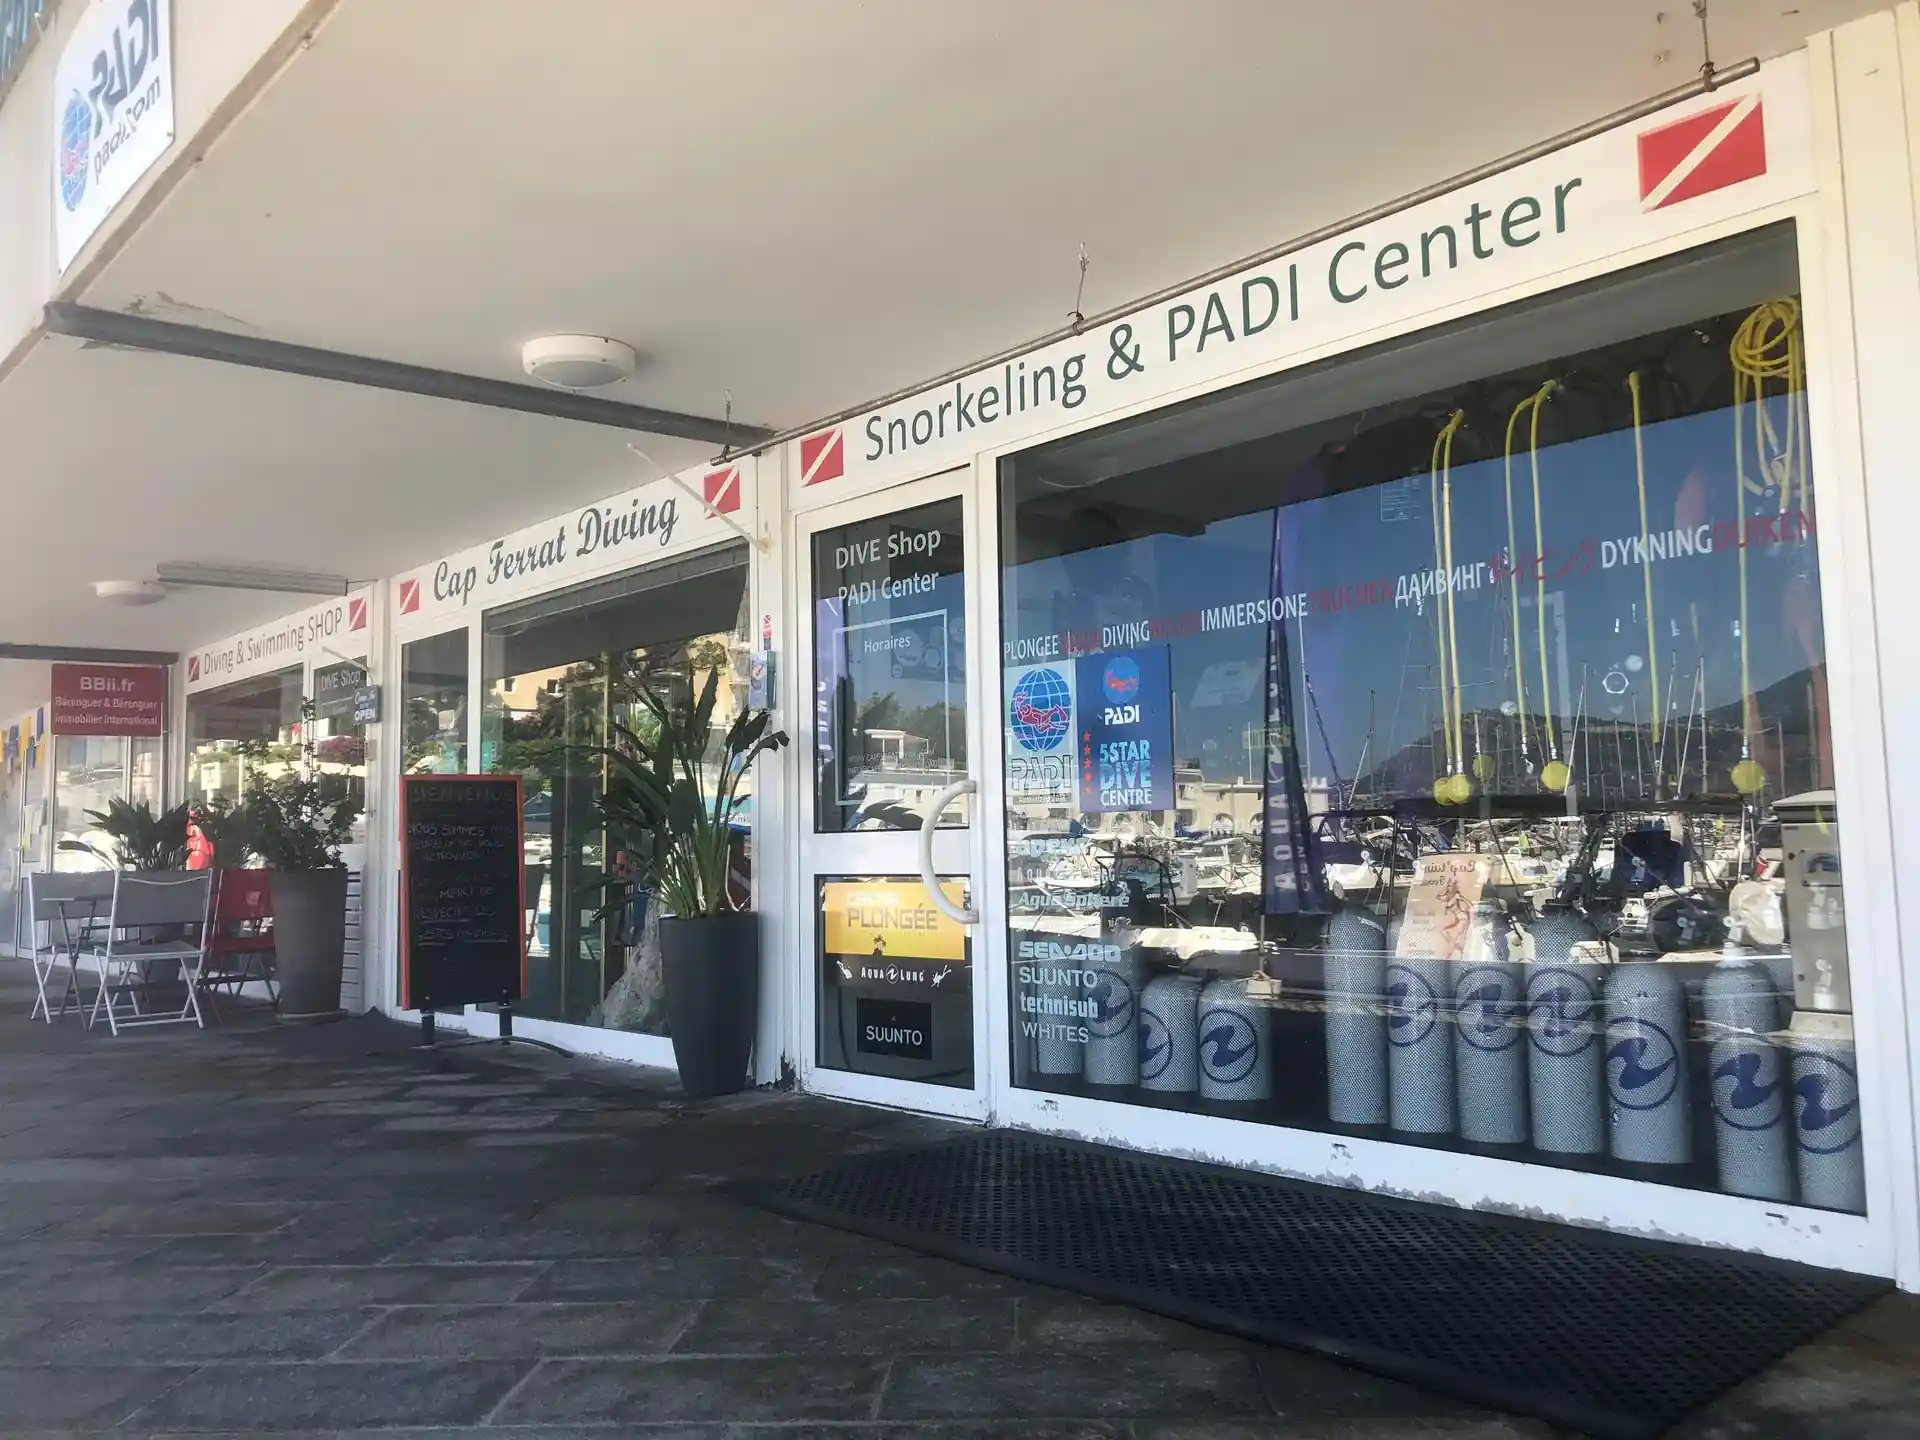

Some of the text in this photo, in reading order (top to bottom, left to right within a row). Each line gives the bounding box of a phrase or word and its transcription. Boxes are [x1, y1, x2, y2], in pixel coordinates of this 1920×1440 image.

[865, 176, 1582, 461] Snorkeling & PADI Center
[433, 496, 679, 606] Cap Ferrat Diving
[835, 529, 941, 570] DIVE Shop
[1601, 524, 1714, 569] DYKNING
[838, 570, 939, 609] PADI Center
[1395, 562, 1485, 609] ДАЙВИНГ
[1201, 593, 1308, 632] IMMERSIONE
[203, 607, 343, 676] Diving & Swimming SHOP
[864, 635, 911, 655] Horaires
[1004, 634, 1060, 660] PLONGEE
[1102, 620, 1150, 648] DIVING
[80, 676, 137, 693] BBii.fr
[321, 669, 361, 692] DIVE Shop
[104, 697, 111, 707] &
[354, 707, 377, 721] OPEN
[1104, 704, 1140, 726] PADI
[104, 713, 158, 726] international
[1011, 754, 1073, 791] PADI
[1100, 762, 1152, 790] DIVE
[1100, 789, 1153, 806] CENTRE
[408, 823, 438, 837] NOUS
[1268, 793, 1297, 890] AQUA
[846, 902, 938, 930] PLONGÉE
[861, 966, 925, 982] AQUA LUNG
[1019, 967, 1099, 988] SUUNTO
[1020, 991, 1099, 1019] technisub
[866, 1024, 923, 1046] SUUNTO
[1022, 1022, 1090, 1044] WHITES
